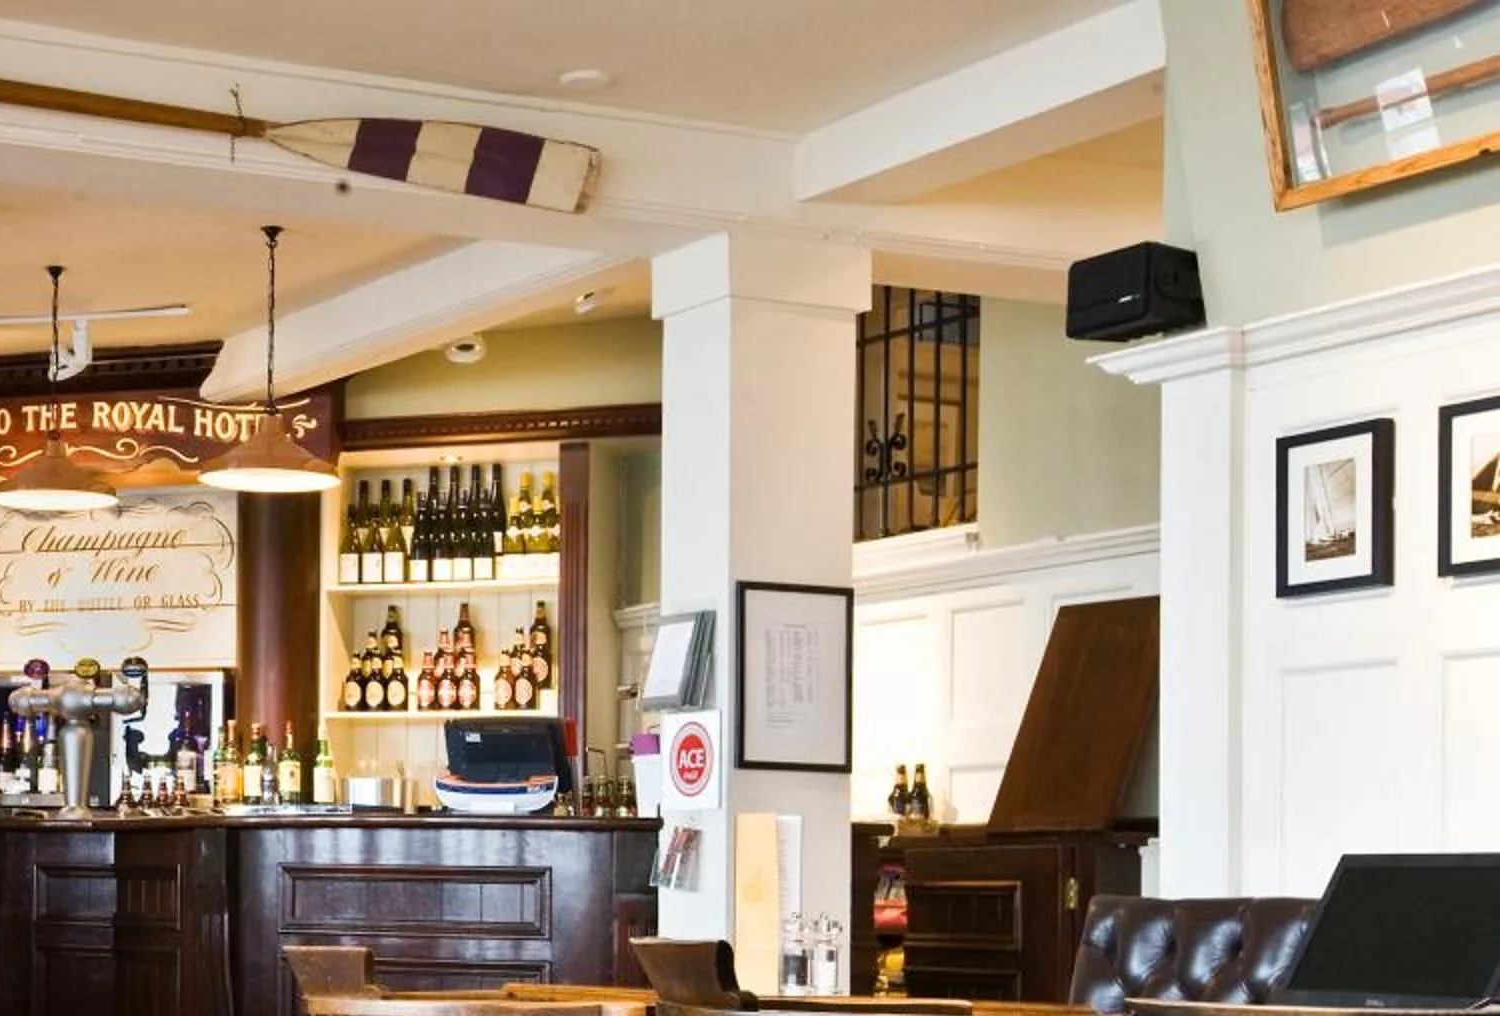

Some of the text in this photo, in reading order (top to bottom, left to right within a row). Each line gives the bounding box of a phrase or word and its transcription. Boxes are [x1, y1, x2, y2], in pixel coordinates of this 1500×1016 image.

[22, 402, 78, 432] THE
[92, 401, 185, 435] ROYAL
[193, 409, 291, 443] HOT
[20, 525, 189, 557] Champagne
[91, 559, 160, 584] Wine
[133, 594, 151, 610] OR
[161, 593, 201, 609] GLASS
[679, 748, 705, 769] ACE
